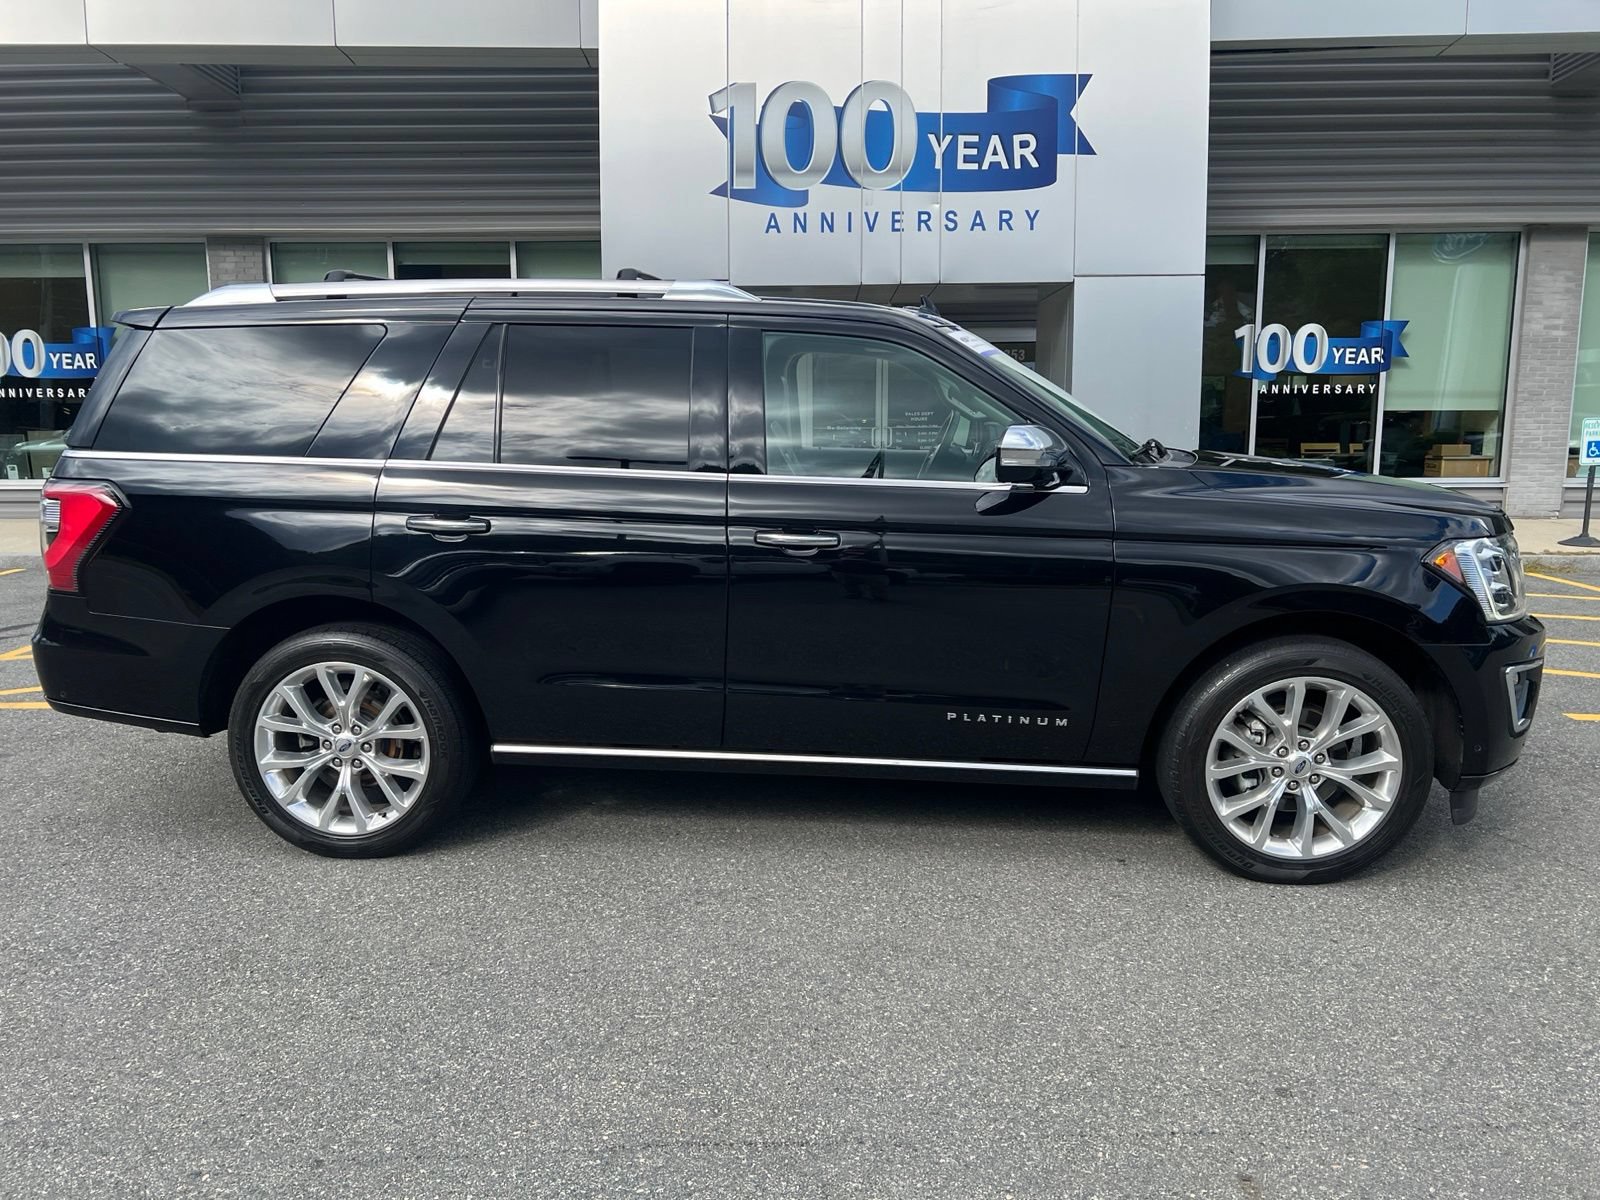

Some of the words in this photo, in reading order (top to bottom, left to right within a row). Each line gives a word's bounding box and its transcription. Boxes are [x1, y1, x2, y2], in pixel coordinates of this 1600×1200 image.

[708, 80, 918, 191] 100
[927, 133, 1040, 171] YEAR
[765, 209, 1041, 234] ANNIVERSARY
[1234, 323, 1329, 374] 100
[1332, 347, 1385, 365] YEAR
[48, 352, 98, 369] YEAR
[0, 388, 91, 398] NNIVERSAR
[1259, 383, 1377, 395] ANNIVERSARY
[946, 712, 1068, 727] PLATINUM
